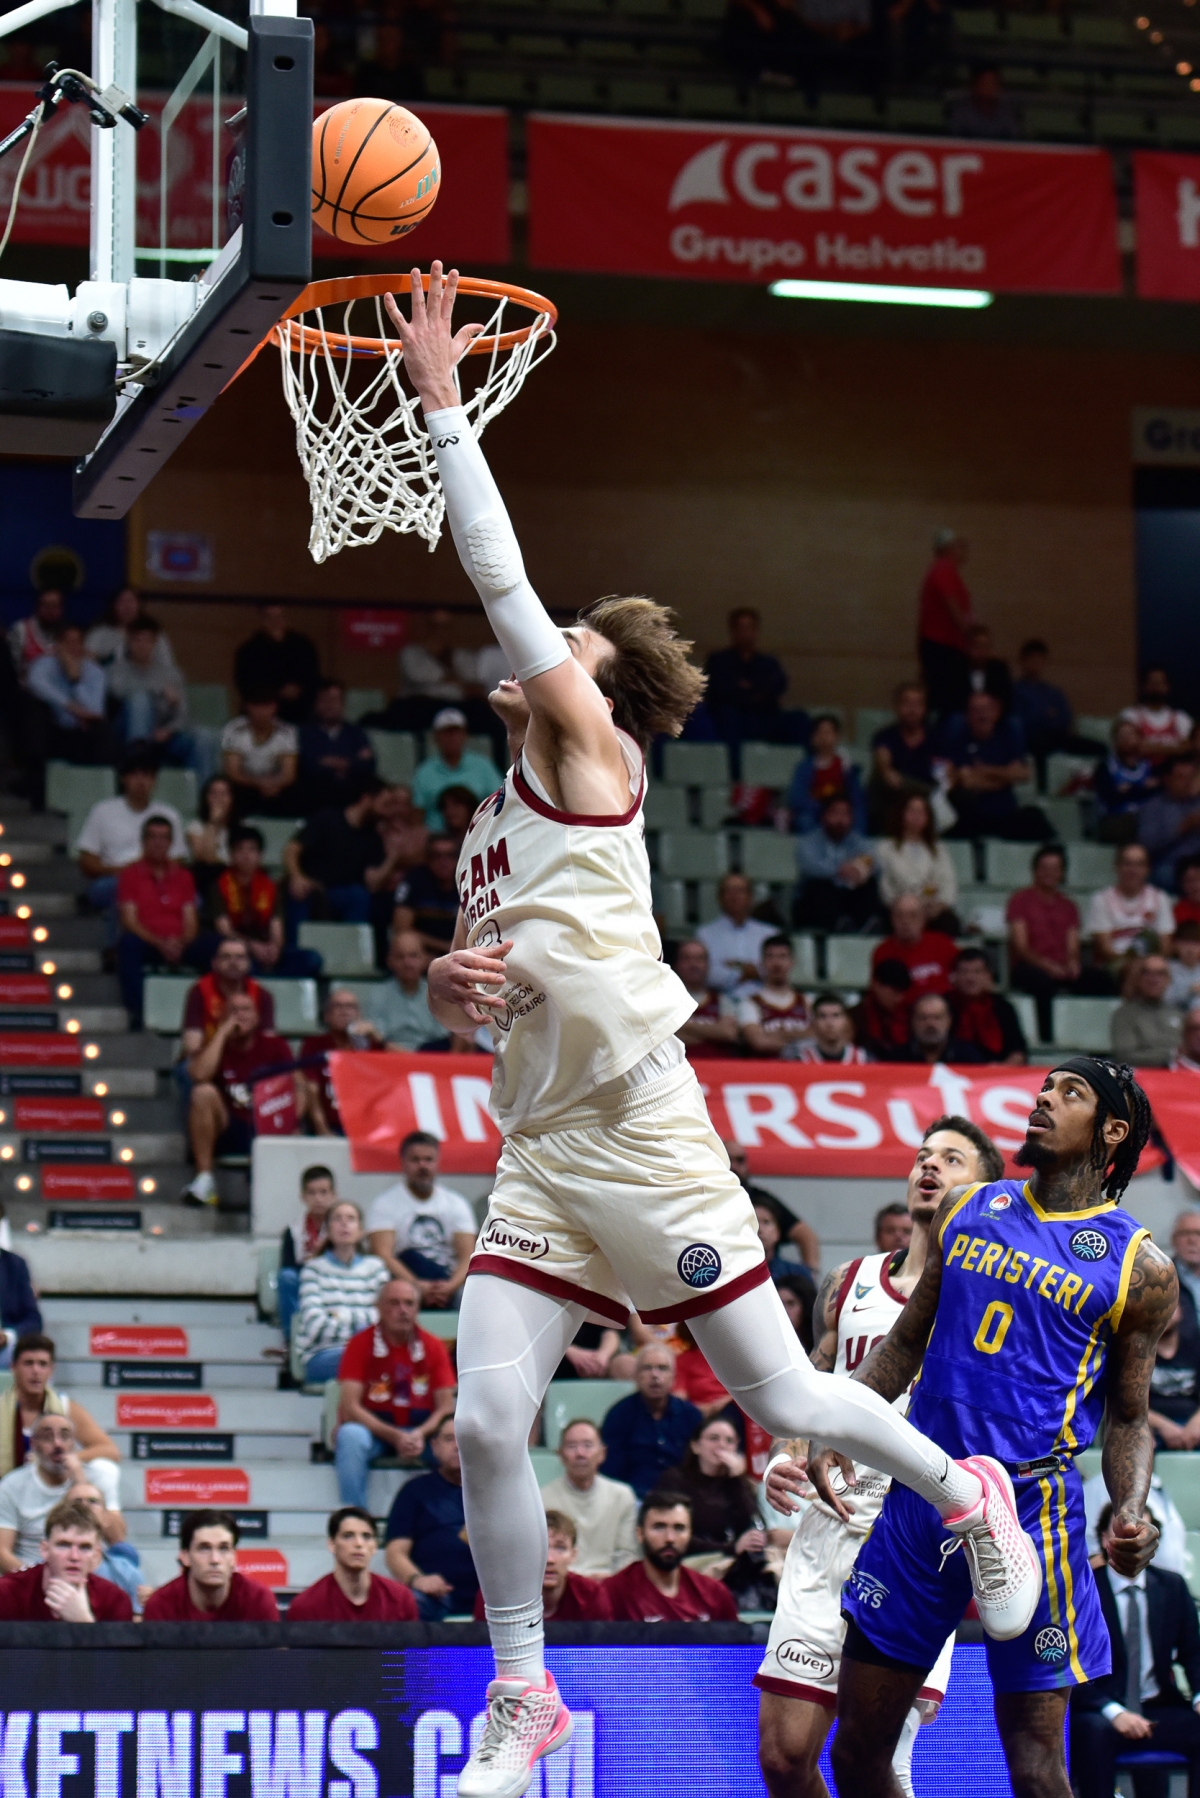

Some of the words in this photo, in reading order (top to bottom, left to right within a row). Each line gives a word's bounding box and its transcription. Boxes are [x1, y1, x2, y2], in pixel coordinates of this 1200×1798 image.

[733, 143, 982, 216] caser
[670, 224, 806, 274] Grupo
[815, 233, 985, 272] Helvetia
[486, 1228, 541, 1253] Juver
[945, 1233, 1094, 1316] PERISTERI
[973, 1300, 1014, 1355] 0
[781, 1647, 828, 1672] Juver
